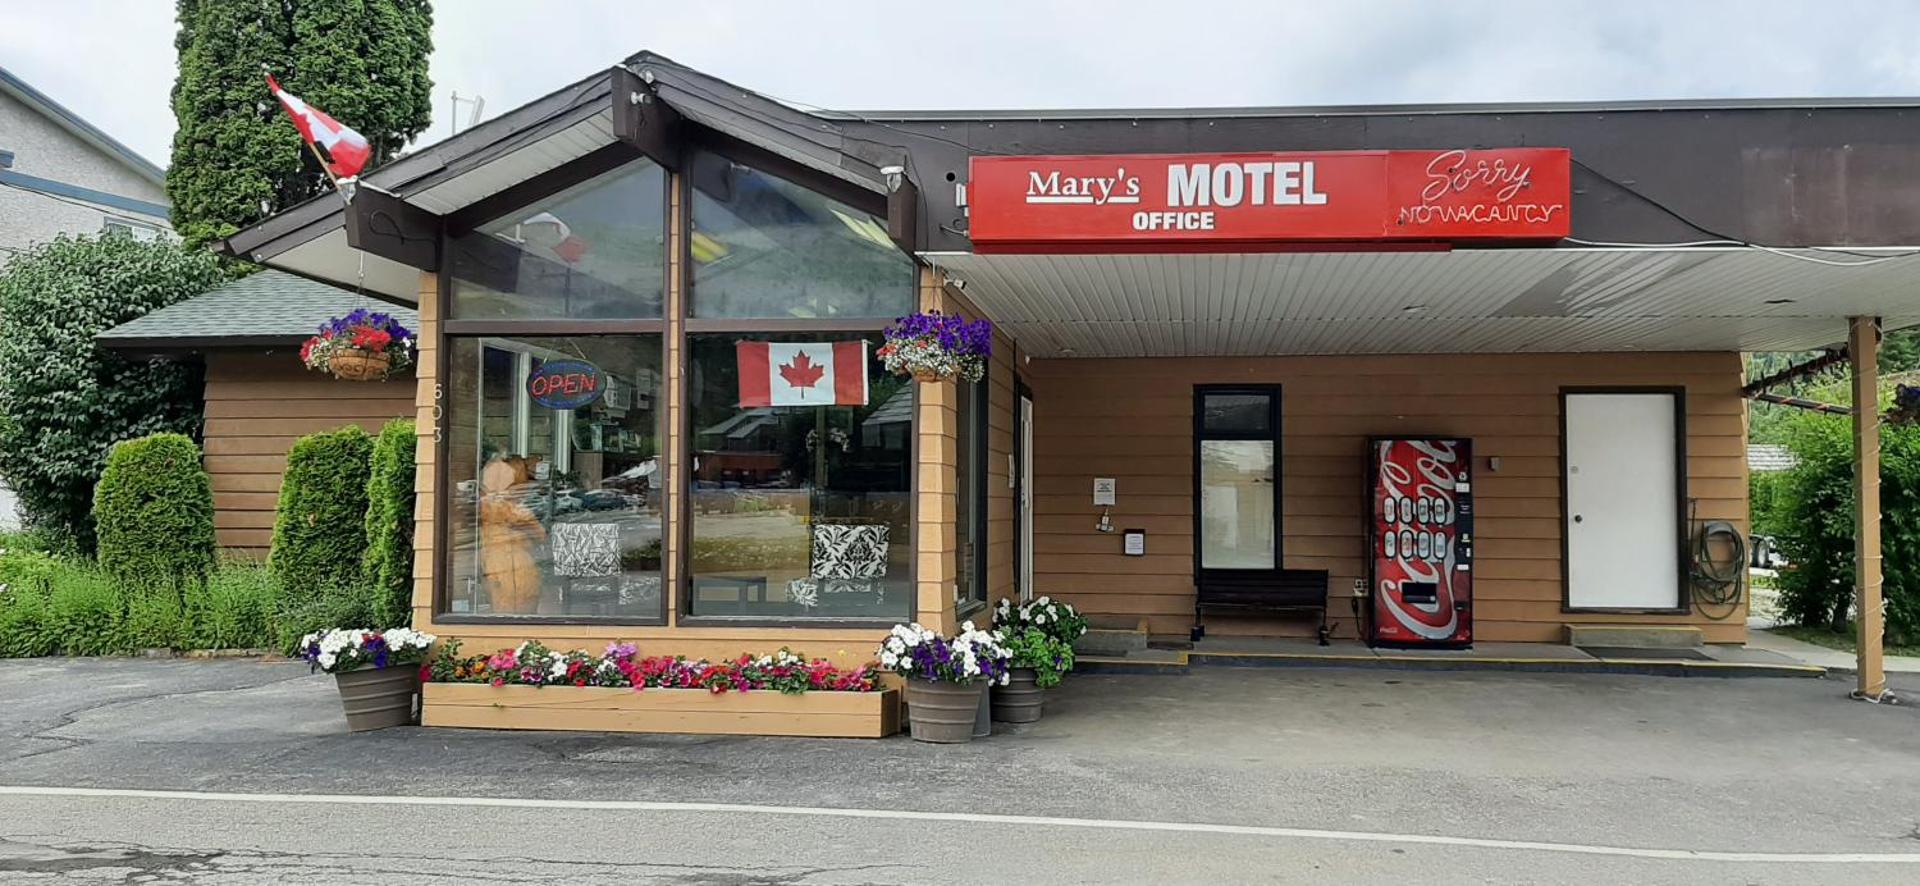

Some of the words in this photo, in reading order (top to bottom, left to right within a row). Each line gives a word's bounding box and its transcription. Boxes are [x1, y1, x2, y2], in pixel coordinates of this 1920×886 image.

[1026, 167, 1140, 205] Mary's
[1167, 161, 1327, 207] MOTEL
[1421, 149, 1531, 202] Sorry
[1132, 211, 1215, 231] OFFICE
[530, 372, 597, 397] OPEN
[432, 383, 443, 443] 603
